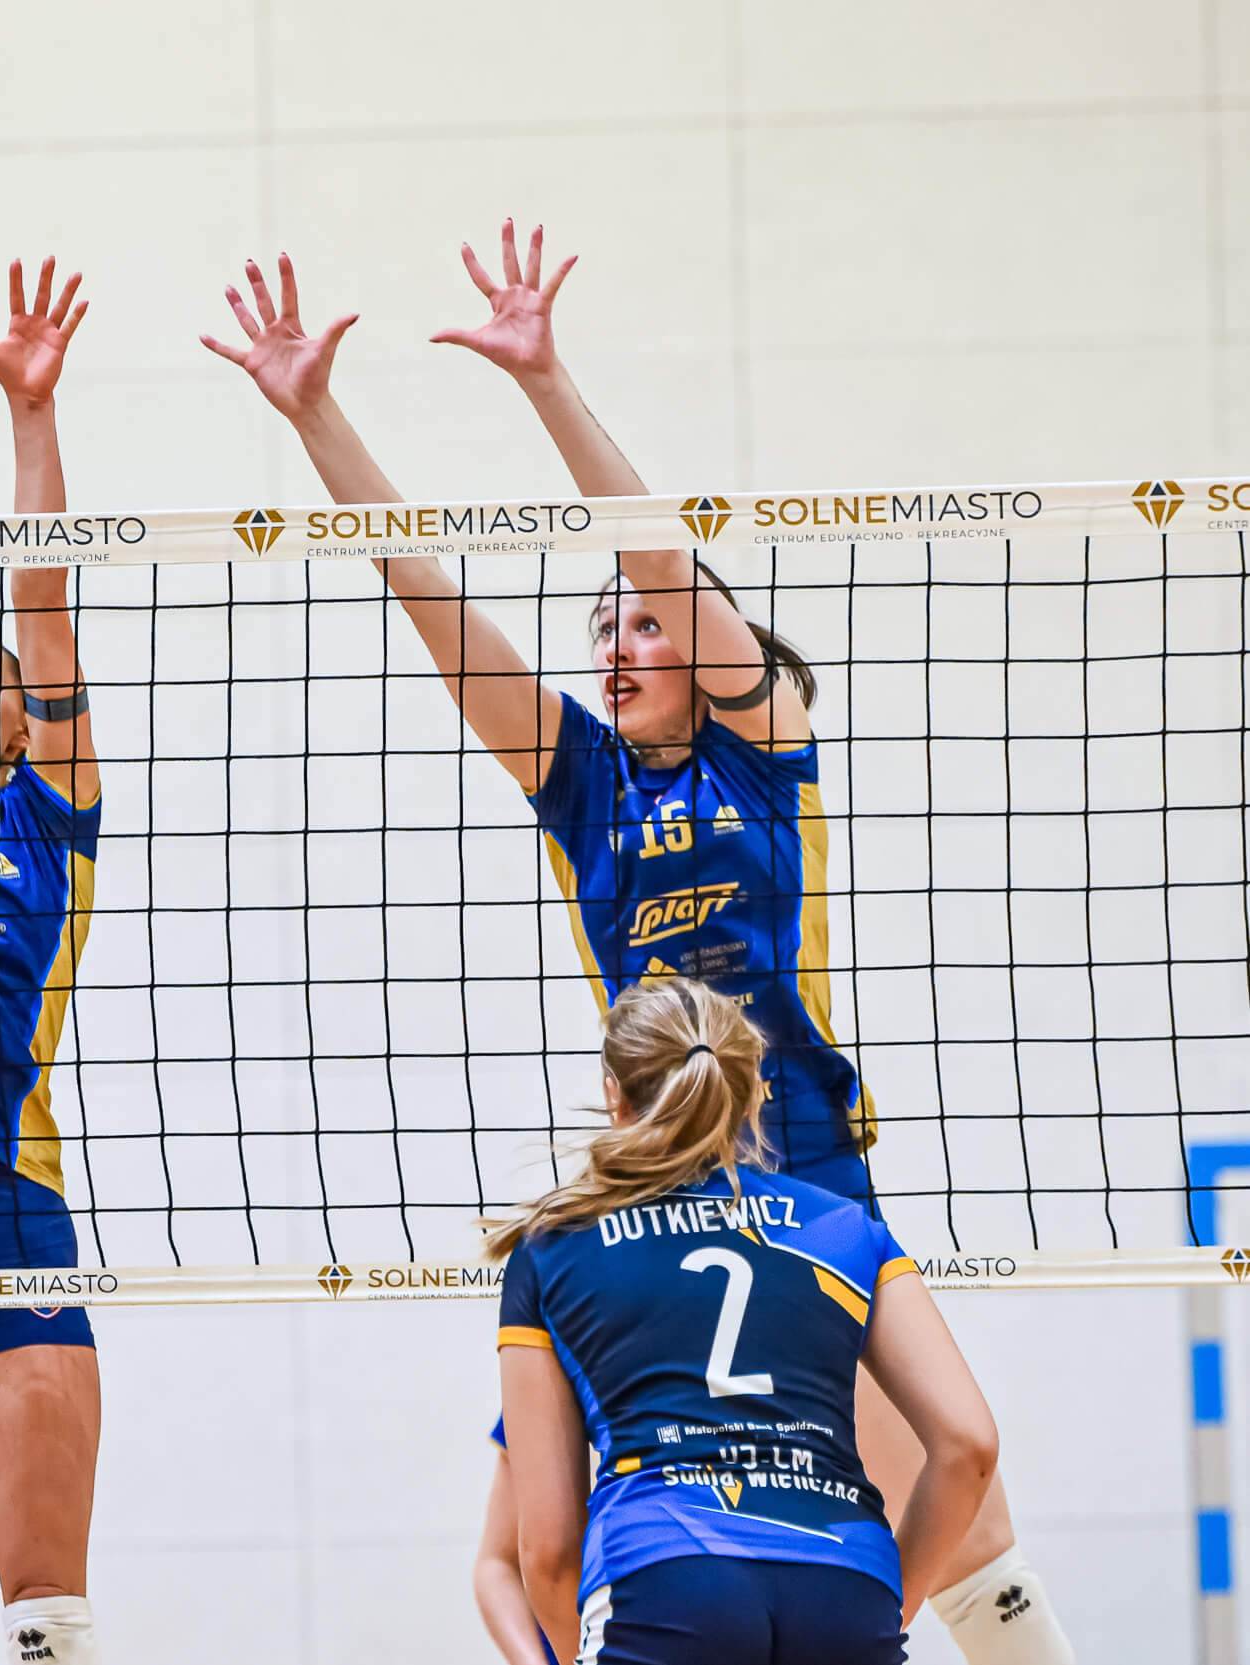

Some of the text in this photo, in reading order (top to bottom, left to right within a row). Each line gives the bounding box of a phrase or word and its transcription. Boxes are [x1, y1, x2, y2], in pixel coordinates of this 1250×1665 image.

[754, 491, 1042, 527] SOLNEMIASTO
[1208, 483, 1250, 511] SO
[307, 504, 591, 540] SOLNEMIASTO
[1208, 520, 1249, 529] CENTR
[754, 528, 1006, 545] CENTRUM EDUKACYJNO REKREACYJNE
[23, 553, 111, 564] REKREACYJNE
[307, 541, 556, 557] CENTRUM EDUKACYJNO REKREACYJNE
[639, 800, 693, 859] 15
[599, 1195, 801, 1248] DUTKIEWICZ
[367, 1268, 504, 1288] SOLNEMIA
[914, 1257, 1016, 1278] MIASTO
[679, 1247, 774, 1398] 2
